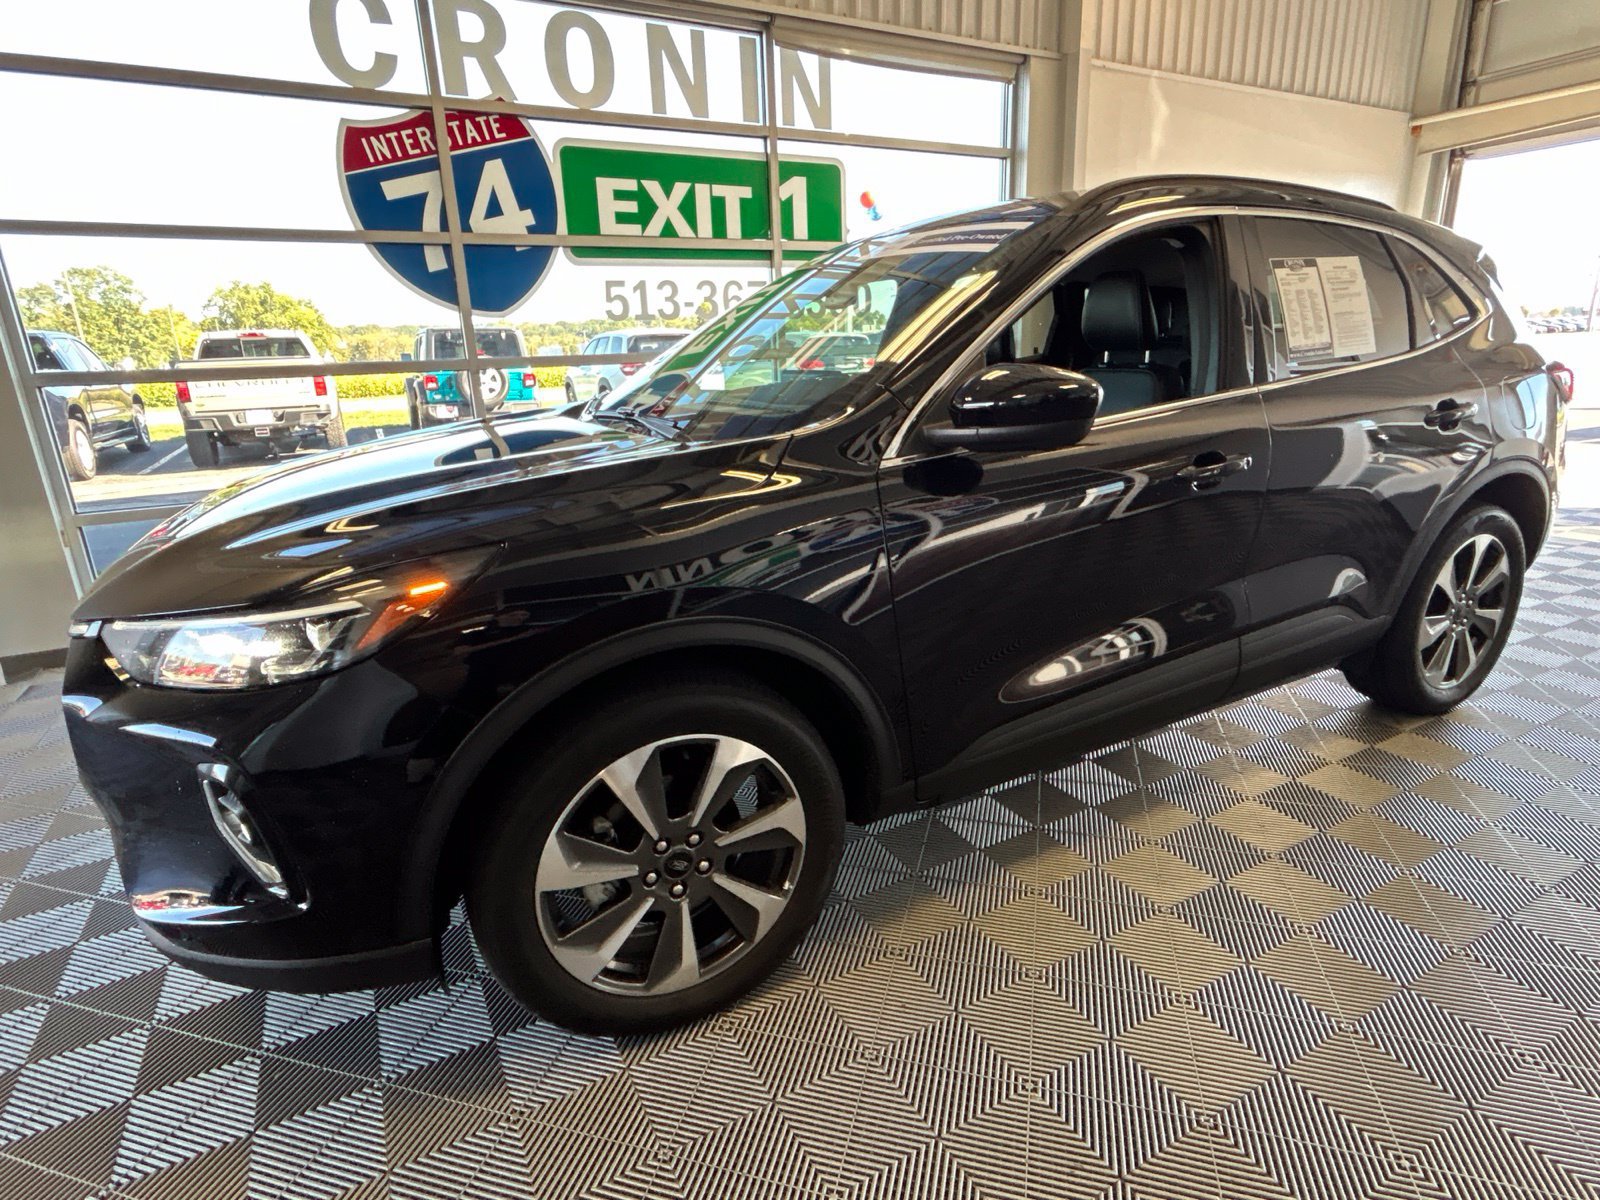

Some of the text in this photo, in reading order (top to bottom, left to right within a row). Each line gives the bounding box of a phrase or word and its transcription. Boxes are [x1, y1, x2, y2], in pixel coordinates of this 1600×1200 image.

[308, 0, 833, 131] CRONIN
[361, 115, 507, 163] INTERTATE
[379, 158, 536, 273] 74
[595, 176, 809, 240] EXIT 1
